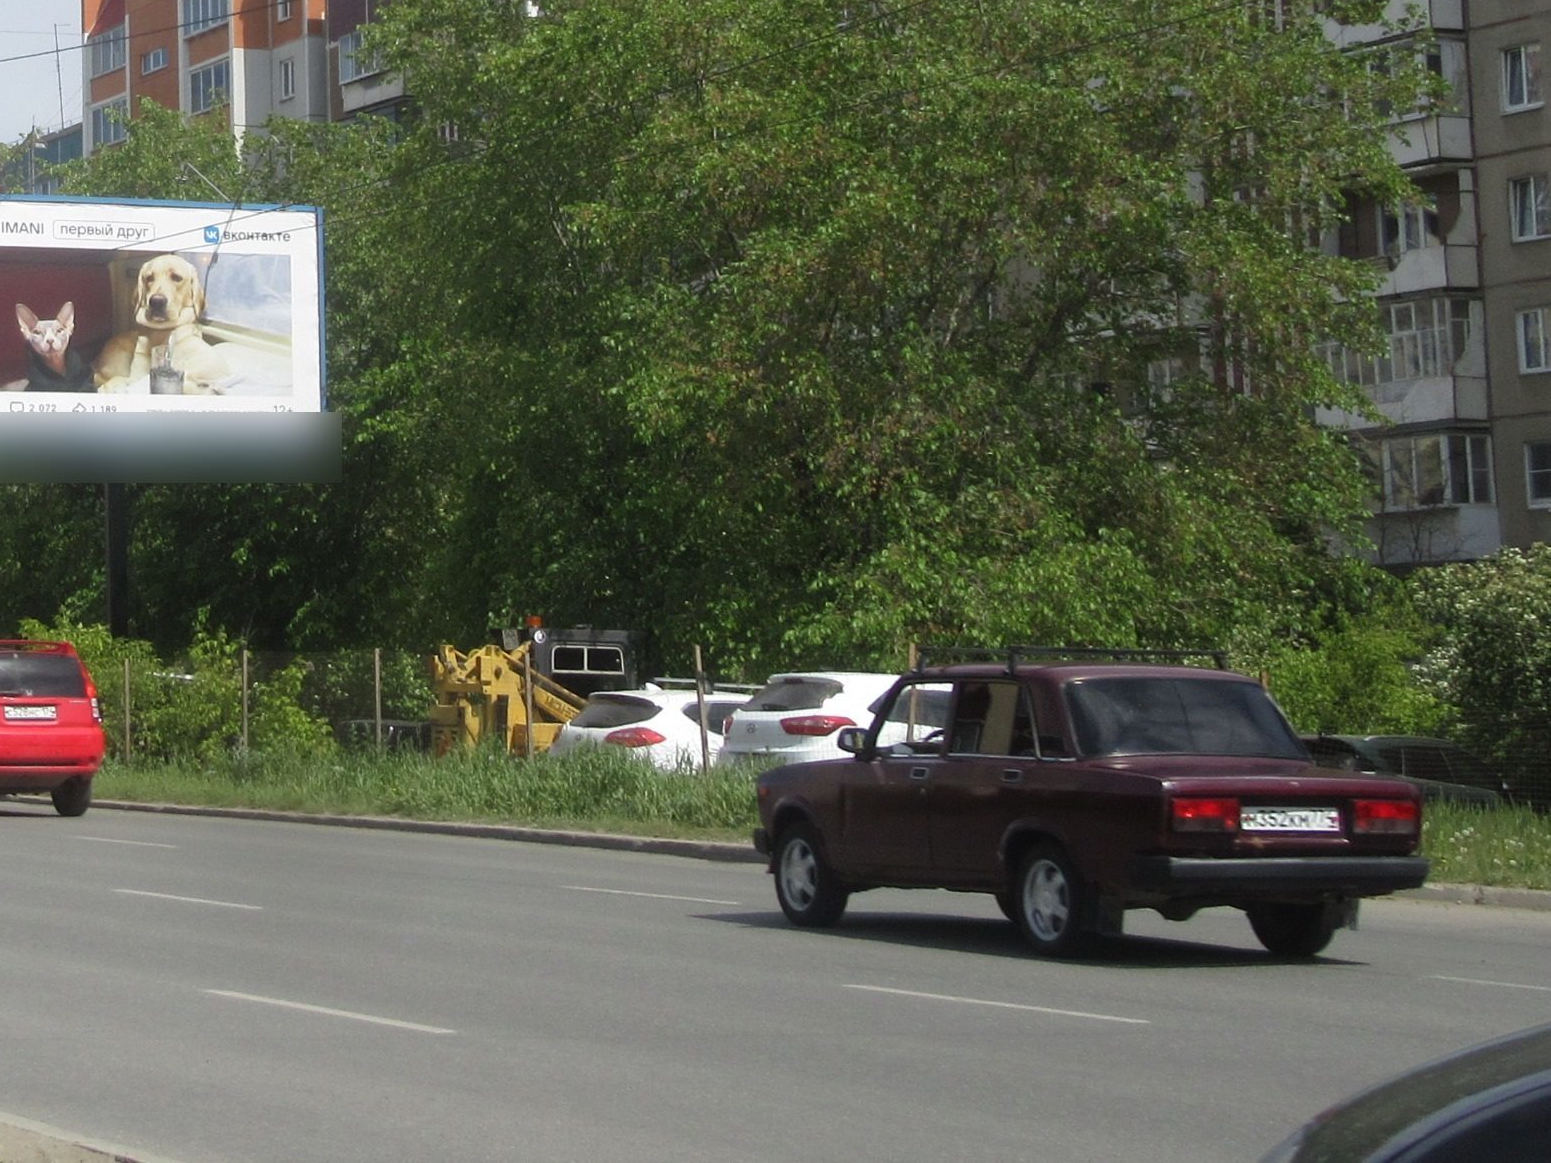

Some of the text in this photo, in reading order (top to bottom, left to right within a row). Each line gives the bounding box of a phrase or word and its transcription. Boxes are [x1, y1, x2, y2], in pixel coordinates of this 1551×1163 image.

[60, 222, 150, 240] первый друг
[223, 230, 291, 242] вконтакте
